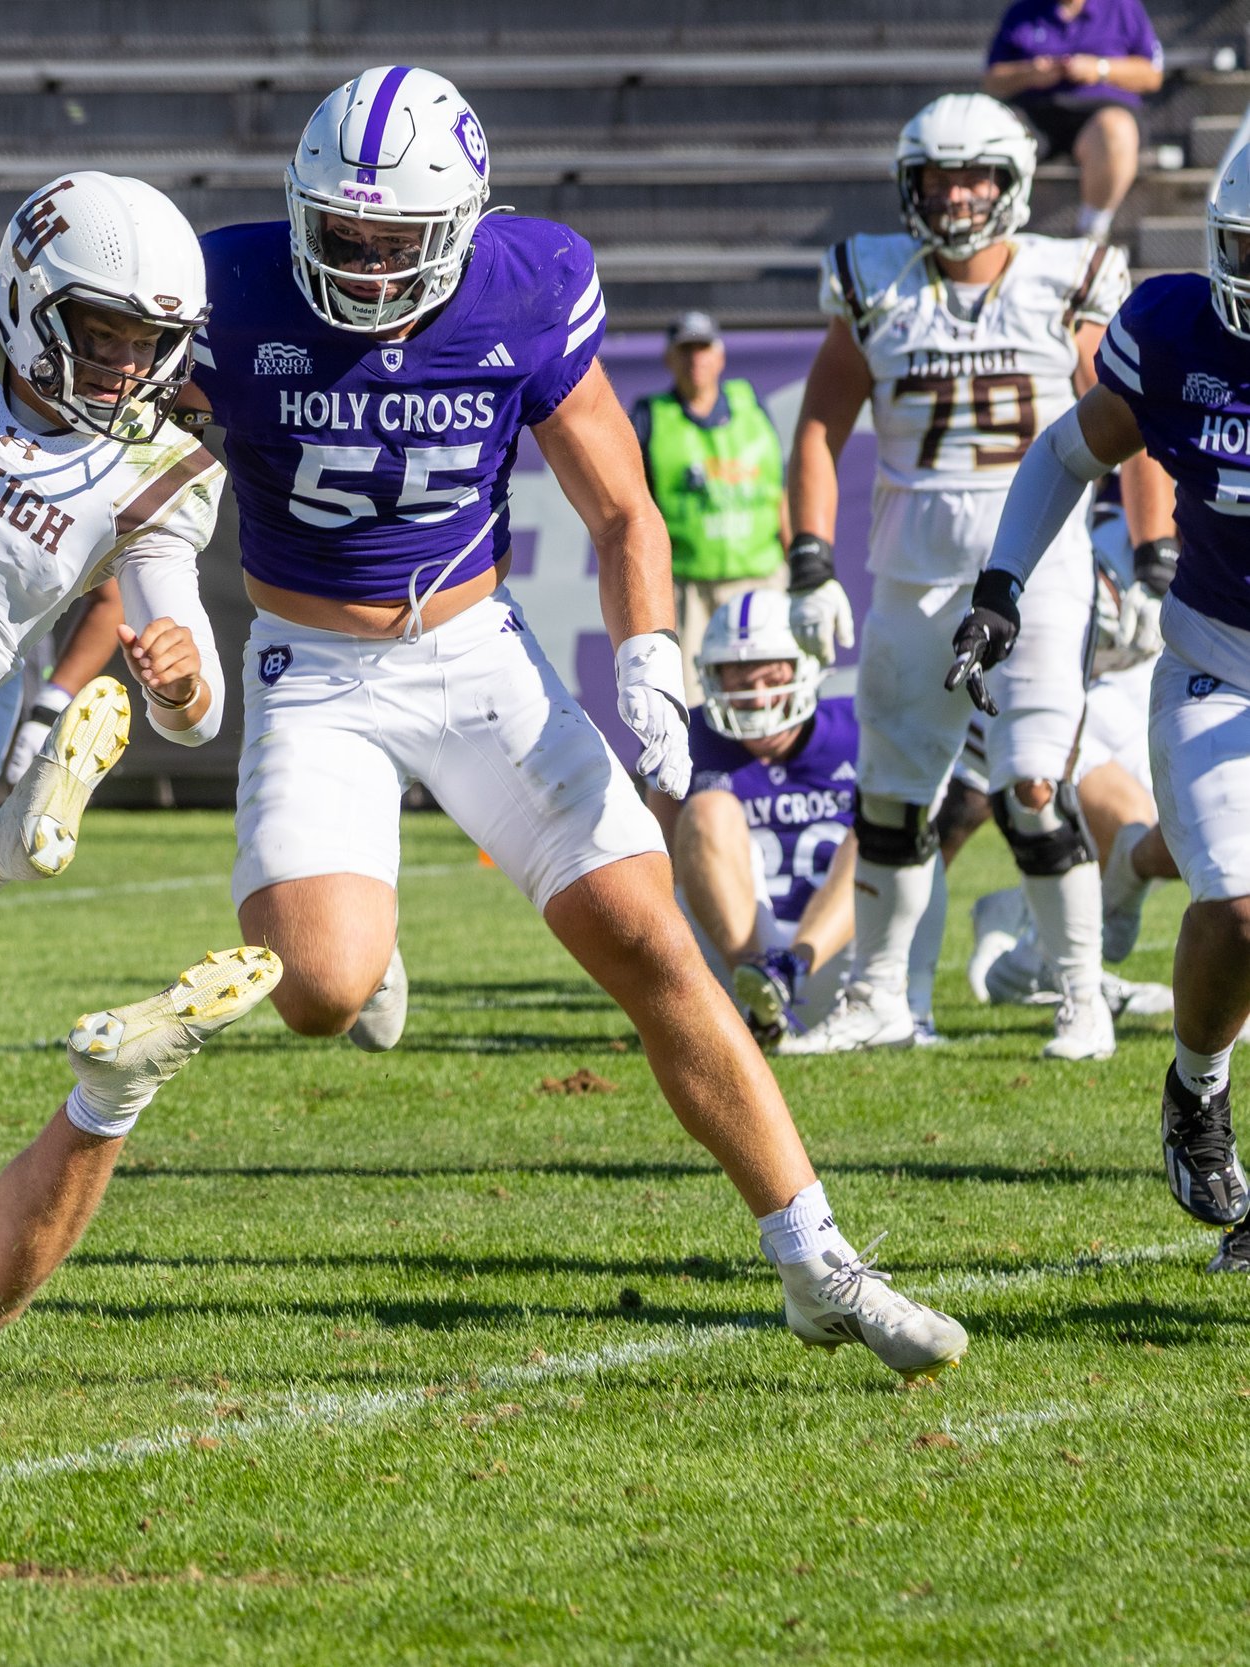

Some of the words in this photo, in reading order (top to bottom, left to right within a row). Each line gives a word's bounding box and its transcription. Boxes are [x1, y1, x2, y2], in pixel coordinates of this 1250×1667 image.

[352, 304, 377, 315] Riddell
[253, 358, 314, 368] PATRIOT
[253, 366, 314, 376] LEAGUE
[908, 348, 1018, 378] LEHIGH
[279, 389, 370, 430] HOLY
[379, 390, 496, 432] CROSS
[891, 373, 1038, 472] 79
[1199, 415, 1250, 456] HO
[288, 440, 484, 529] 55
[775, 789, 852, 824] CROSS
